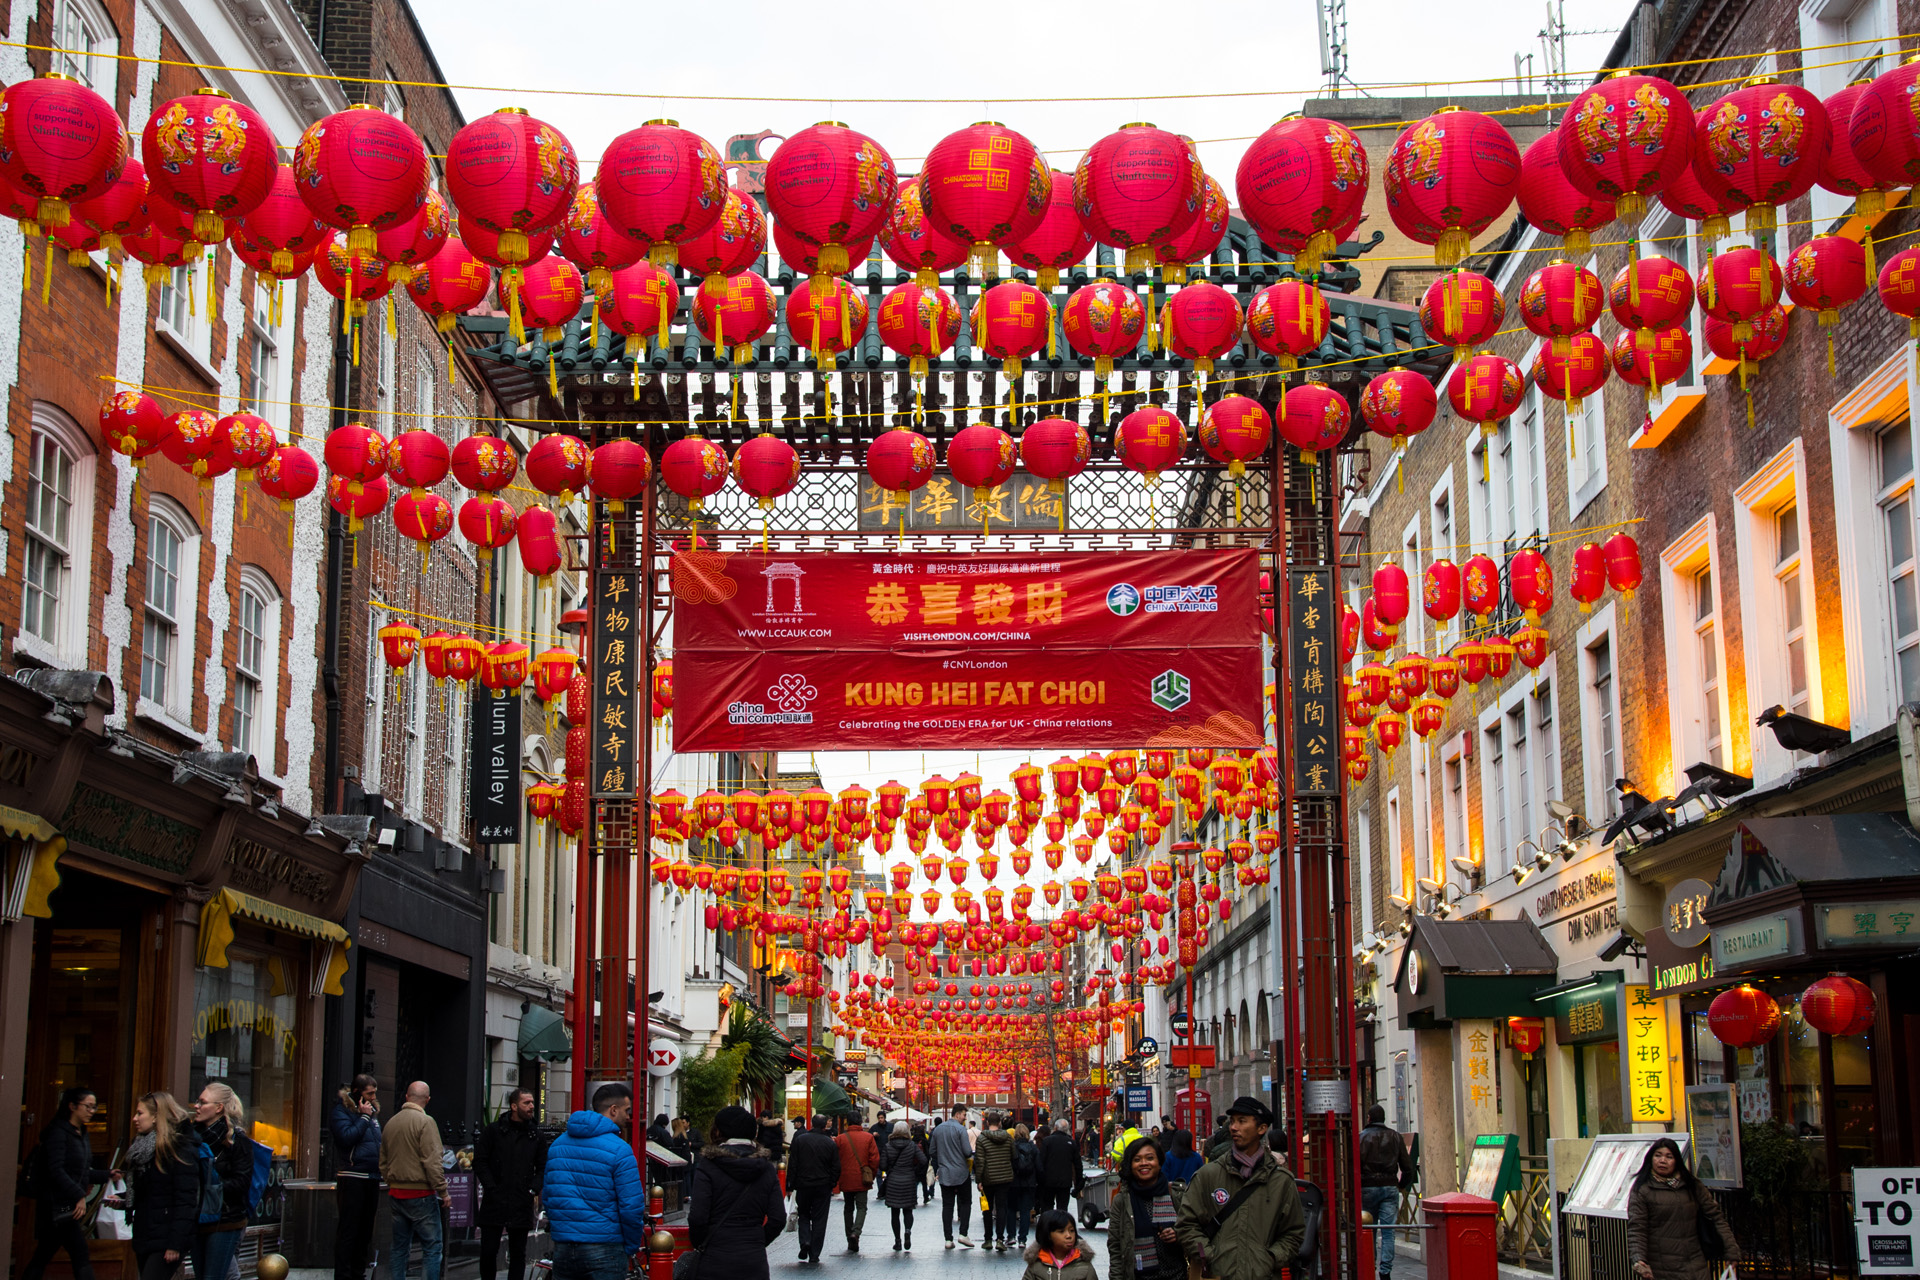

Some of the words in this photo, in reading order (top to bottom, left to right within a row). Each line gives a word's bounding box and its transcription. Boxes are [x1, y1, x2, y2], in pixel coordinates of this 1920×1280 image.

[34, 112, 83, 127] supported
[85, 121, 96, 131] by
[33, 124, 95, 145] Shaftesbury
[354, 136, 400, 150] supported
[402, 145, 410, 154] by
[459, 140, 500, 154] supported
[501, 141, 512, 150] by
[354, 147, 410, 167] Shaftesbury
[459, 154, 512, 168] Shaftesbury
[618, 154, 660, 164] supported
[664, 154, 674, 163] by
[1116, 159, 1162, 168] supported
[1164, 158, 1174, 169] by
[618, 165, 674, 177] Shaftesbury
[779, 164, 818, 177] supported
[820, 162, 832, 172] by
[1116, 170, 1174, 182] Shaftesbury
[1252, 158, 1291, 182] supported
[1292, 153, 1306, 167] by
[779, 174, 832, 191] Shaftesbury
[942, 174, 982, 184] CHINATOWN
[1254, 167, 1308, 194] Shaftesbury
[1145, 586, 1217, 602] 中国太平
[865, 582, 1068, 626] 恭喜發財
[1146, 602, 1176, 612] CHINA
[1178, 602, 1218, 612] TAIPING
[738, 629, 832, 638] WWW.LCCAUK.COM
[903, 632, 1031, 641] VISITLONDON.COM/CHINA
[942, 660, 1008, 670] #CNYLondon
[845, 682, 924, 706] KUNG
[931, 682, 977, 706] HEI
[984, 681, 1034, 706] FAT
[1040, 680, 1106, 705] CHOI
[728, 702, 764, 714] China
[729, 714, 773, 724] unicom
[839, 720, 900, 730] Celebrating
[902, 719, 920, 729] the
[922, 719, 965, 729] GOLDEN
[968, 719, 988, 728] ERA
[990, 719, 1007, 728] for
[1009, 719, 1024, 728] UK
[1033, 718, 1062, 728] China
[1064, 718, 1112, 728] relations
[488, 744, 510, 804] valley
[1536, 882, 1578, 917] CANTONESE
[1578, 882, 1584, 900] &
[1568, 919, 1582, 942] DIM
[1584, 914, 1601, 937] SUM
[1723, 928, 1774, 955] RESTAURANT
[1654, 962, 1697, 991] LONDON
[256, 1004, 297, 1061] BUFFET
[1632, 988, 1664, 1116] 翠亨邨酒家
[1862, 1200, 1912, 1226] TO
